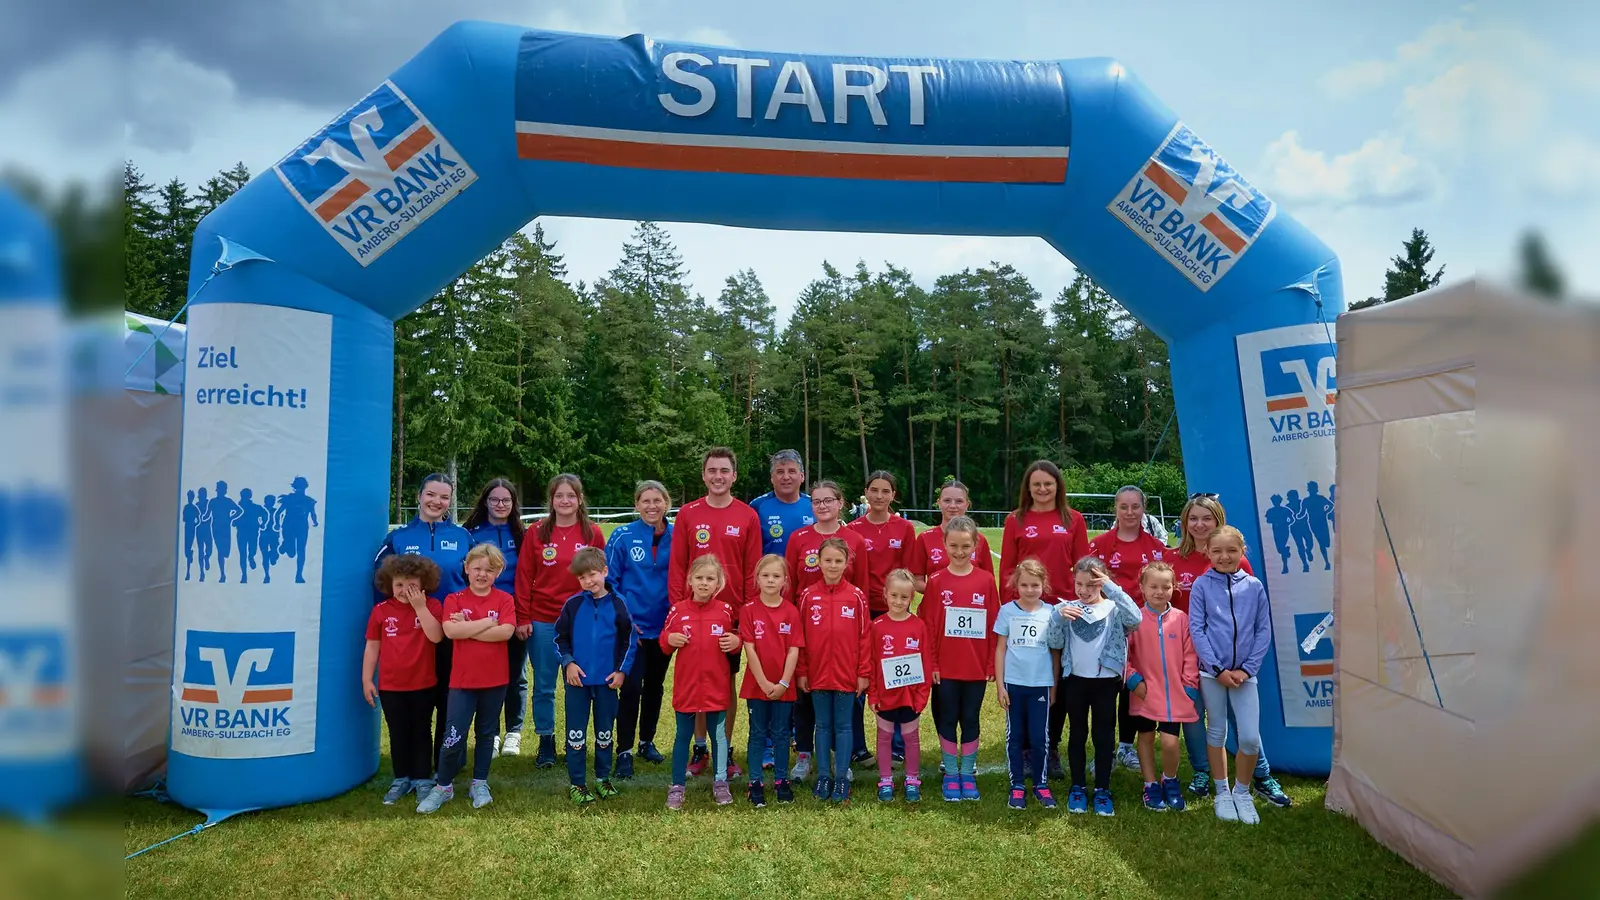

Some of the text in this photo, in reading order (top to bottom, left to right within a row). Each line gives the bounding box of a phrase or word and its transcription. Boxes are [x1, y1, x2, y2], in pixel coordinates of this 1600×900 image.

[658, 52, 938, 126] START
[332, 143, 458, 243] VR BANK
[357, 168, 467, 258] AMBERG-SULZBACH EG
[1129, 178, 1231, 276] VR BANK
[1116, 200, 1212, 284] AMBERG-SULZBACH EG
[197, 345, 239, 369] Ziel
[196, 383, 307, 409] erreicht!
[1269, 414, 1302, 433] VR
[958, 615, 972, 628] 81
[1021, 625, 1037, 637] 76
[895, 664, 911, 677] 82
[1302, 680, 1333, 698] VR
[1305, 699, 1334, 707] AMBE
[180, 706, 291, 729] VR BANK
[181, 727, 291, 739] AMBERG-SULZBACH EG
